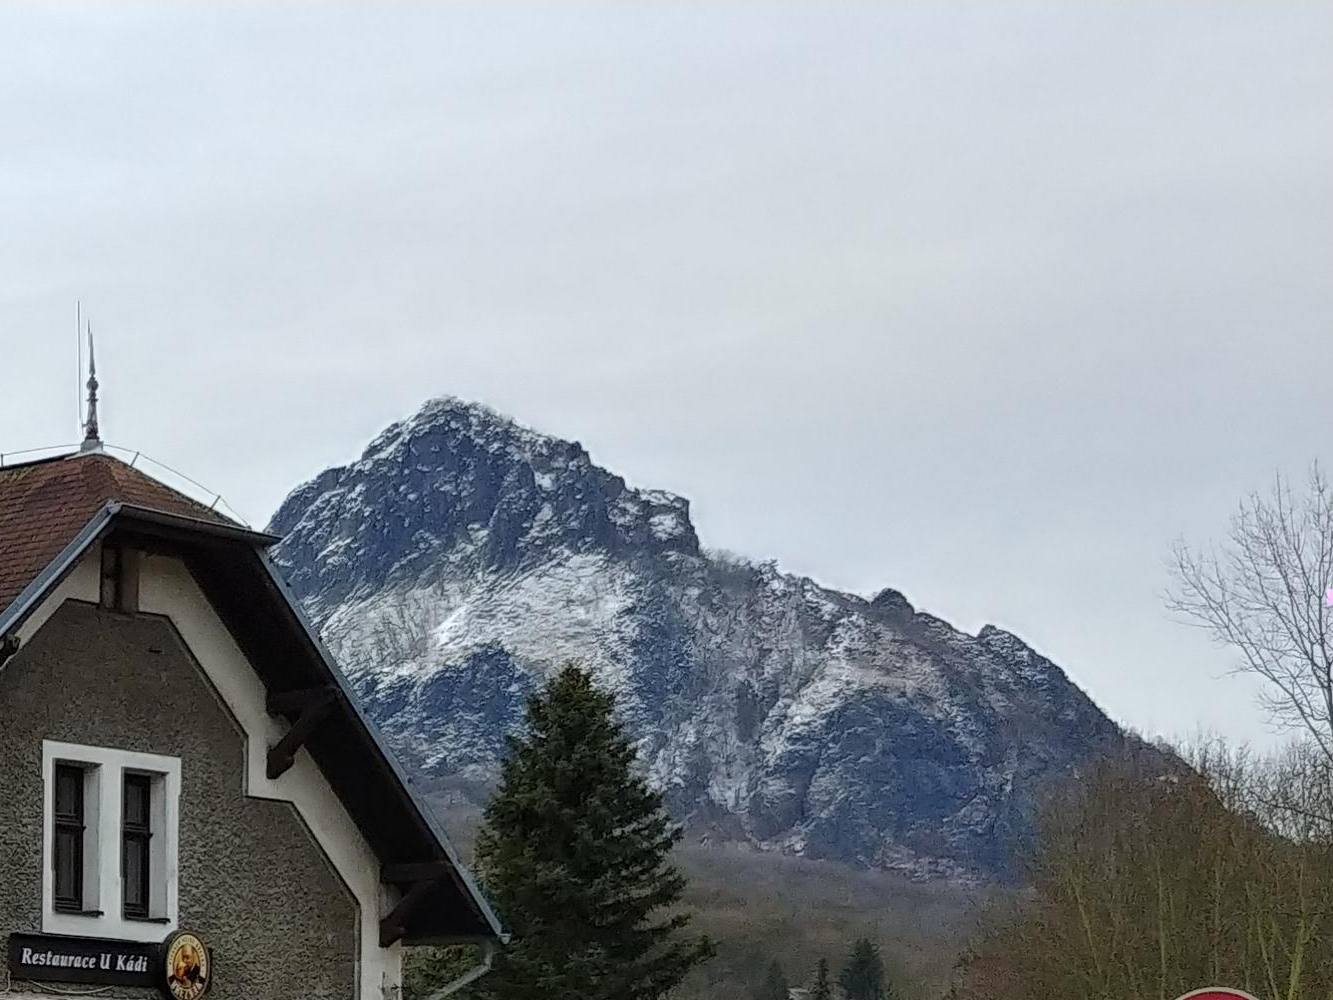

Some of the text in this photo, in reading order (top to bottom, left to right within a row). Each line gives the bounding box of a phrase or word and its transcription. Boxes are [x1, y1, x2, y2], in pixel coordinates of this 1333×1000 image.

[21, 947, 148, 972] Restaurace U Kádi
